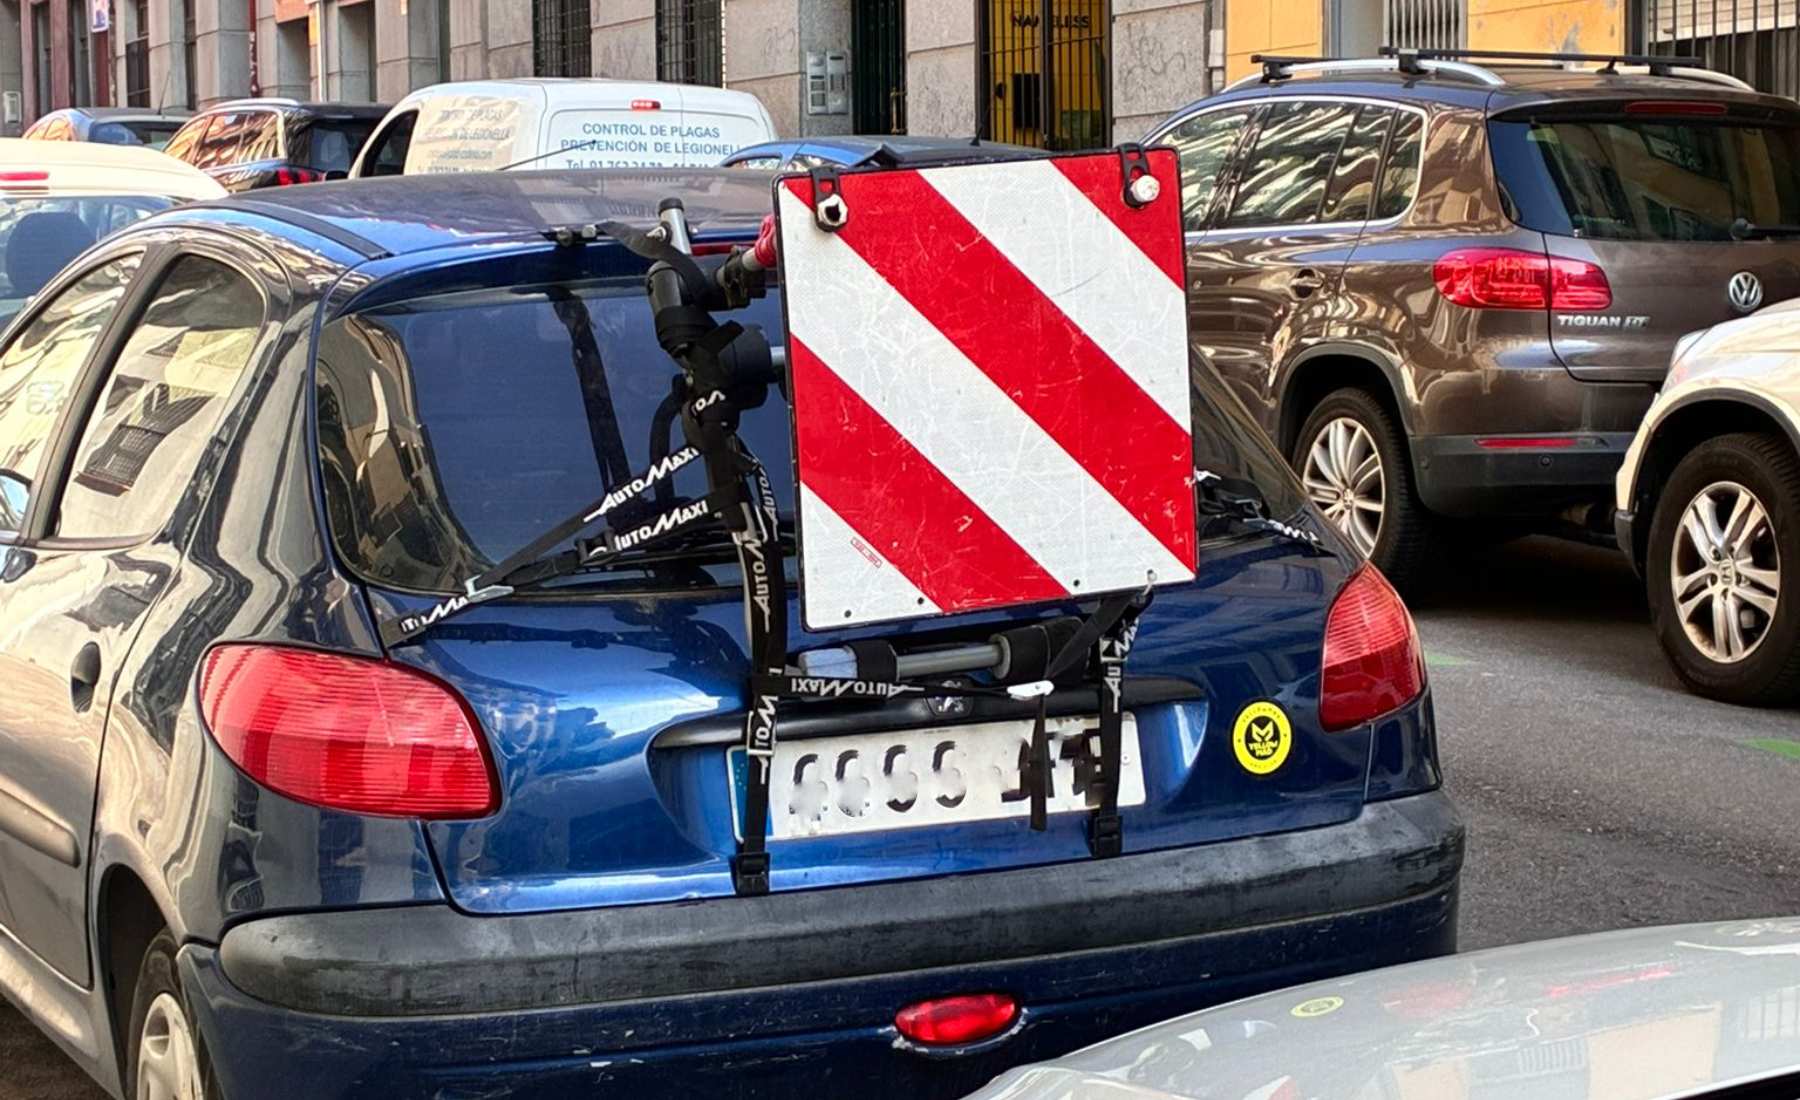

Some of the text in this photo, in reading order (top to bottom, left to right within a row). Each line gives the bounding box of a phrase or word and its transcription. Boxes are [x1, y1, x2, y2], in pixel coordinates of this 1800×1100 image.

[582, 123, 720, 139] CONTROL DE PLAGAS
[561, 138, 647, 152] PREVENCIÓN
[654, 142, 671, 153] DE
[1558, 315, 1621, 328] TIGUAN
